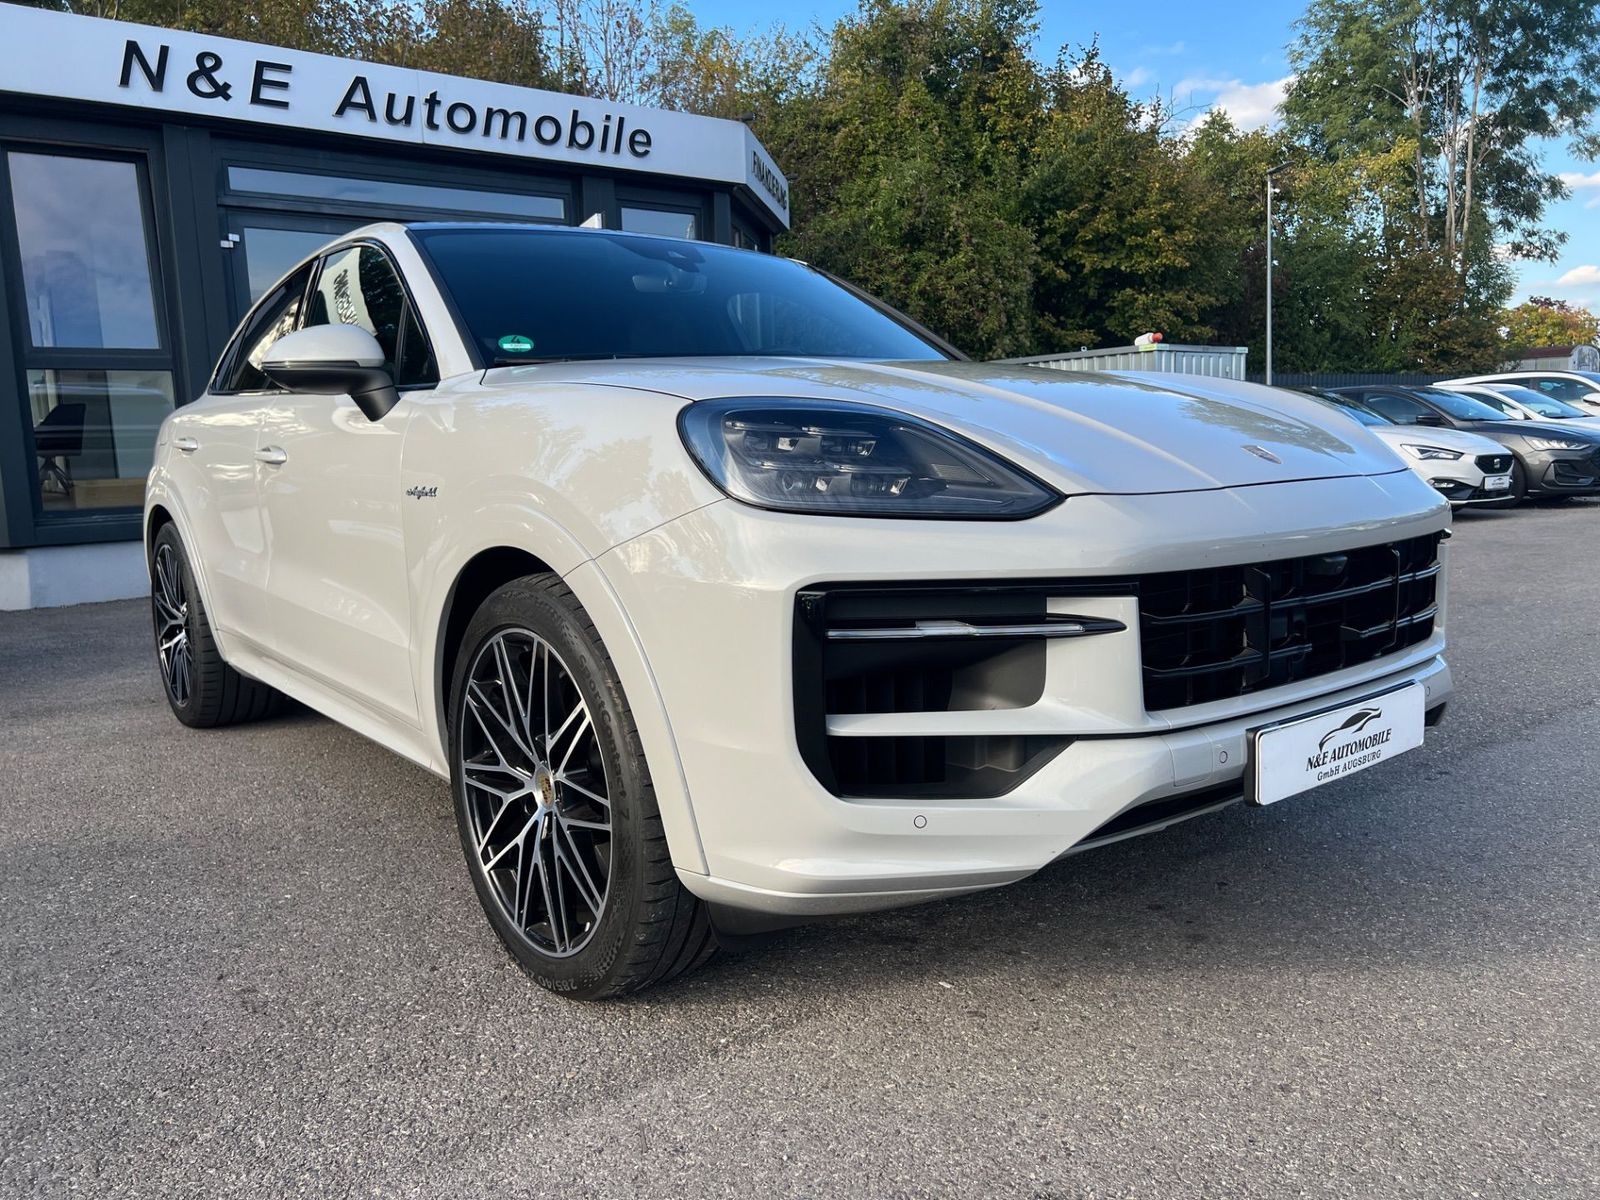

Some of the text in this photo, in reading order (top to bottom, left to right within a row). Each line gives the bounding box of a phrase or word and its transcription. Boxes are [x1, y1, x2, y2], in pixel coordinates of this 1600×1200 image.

[332, 75, 652, 158] Automobile
[1306, 728, 1392, 771] N&E AUTOMOBILE
[1317, 750, 1381, 781] GmbH AUGSBURG
